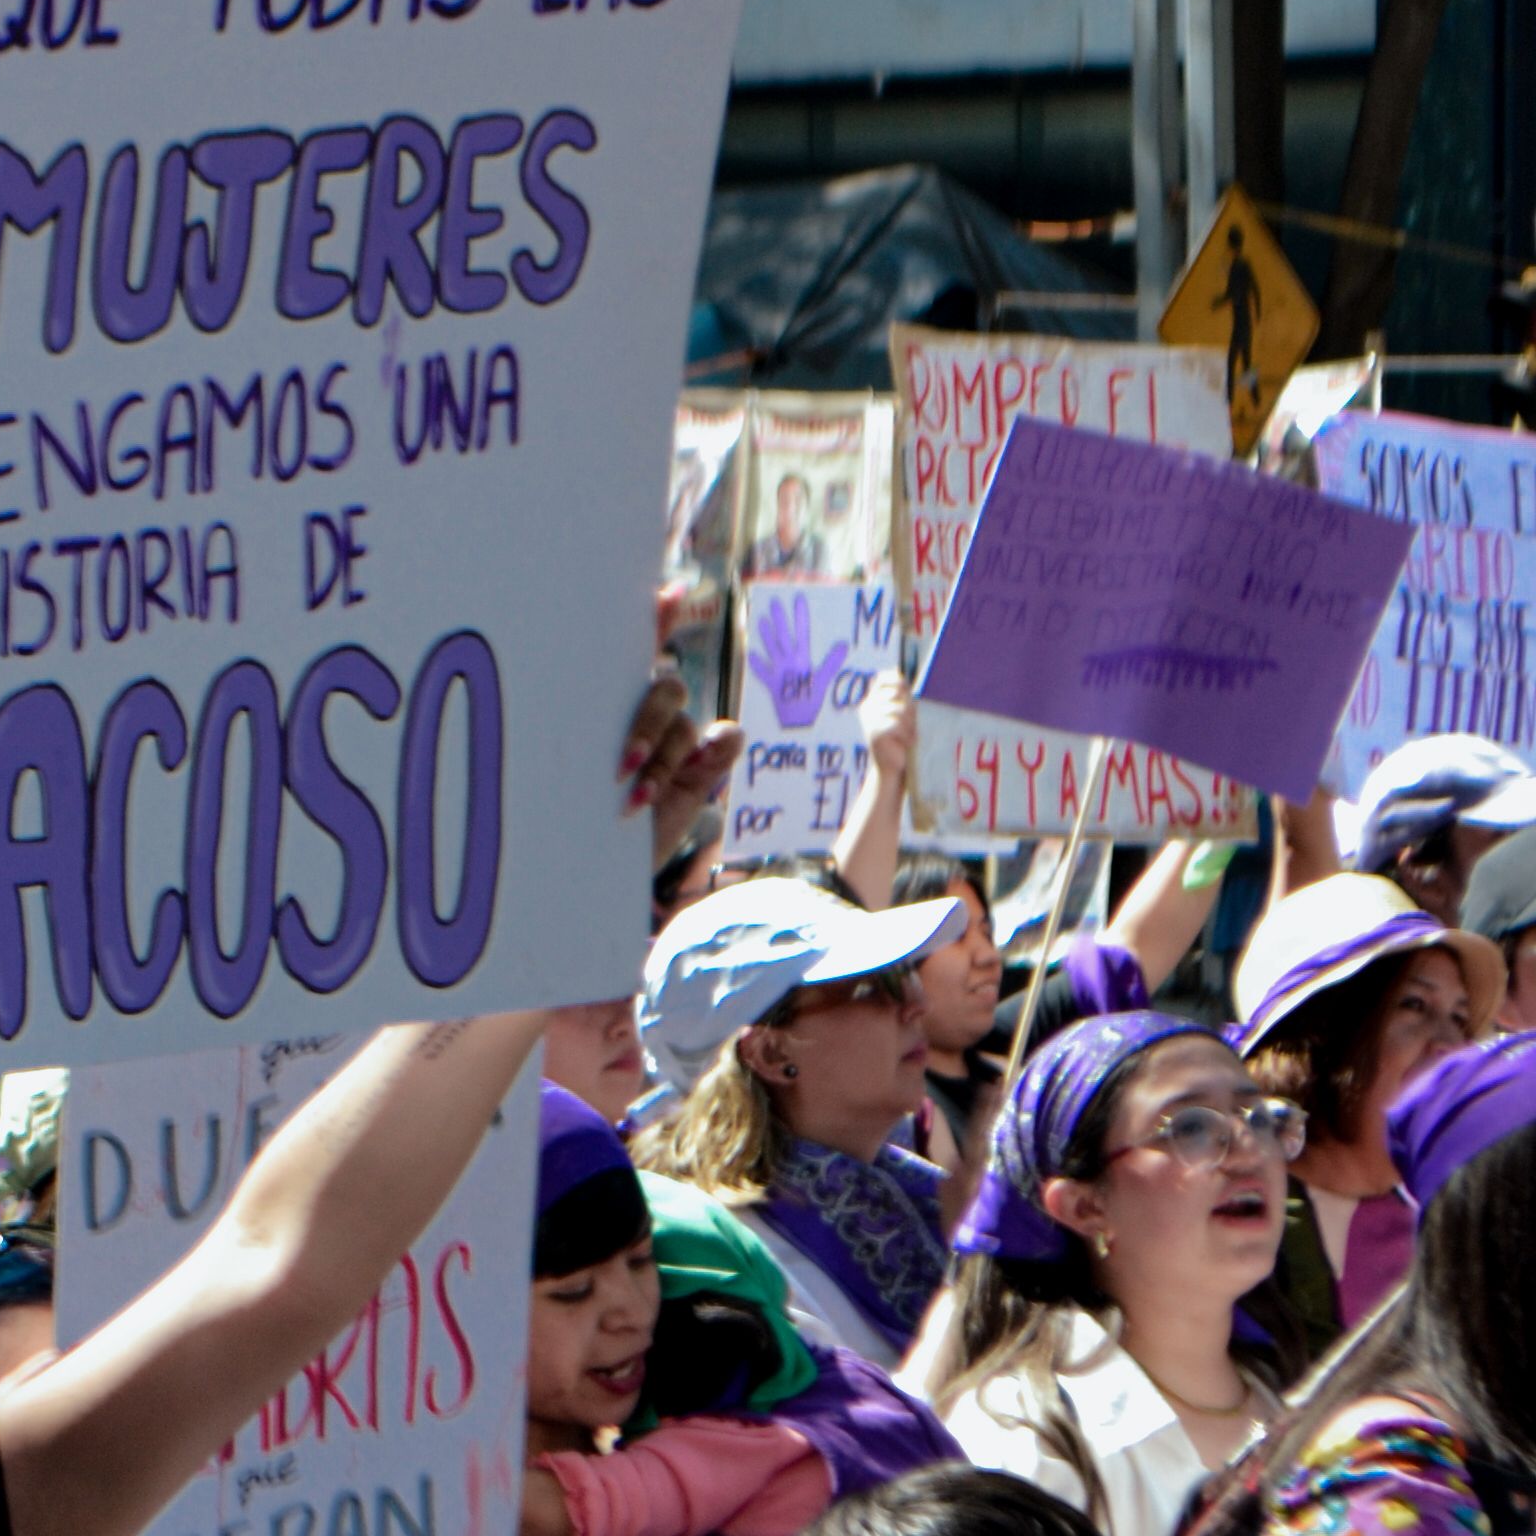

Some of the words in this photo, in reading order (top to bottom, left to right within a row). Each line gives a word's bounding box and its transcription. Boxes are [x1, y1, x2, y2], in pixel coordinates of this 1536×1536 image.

[392, 343, 523, 466] UNA
[303, 502, 372, 612] DE
[734, 805, 784, 842] por
